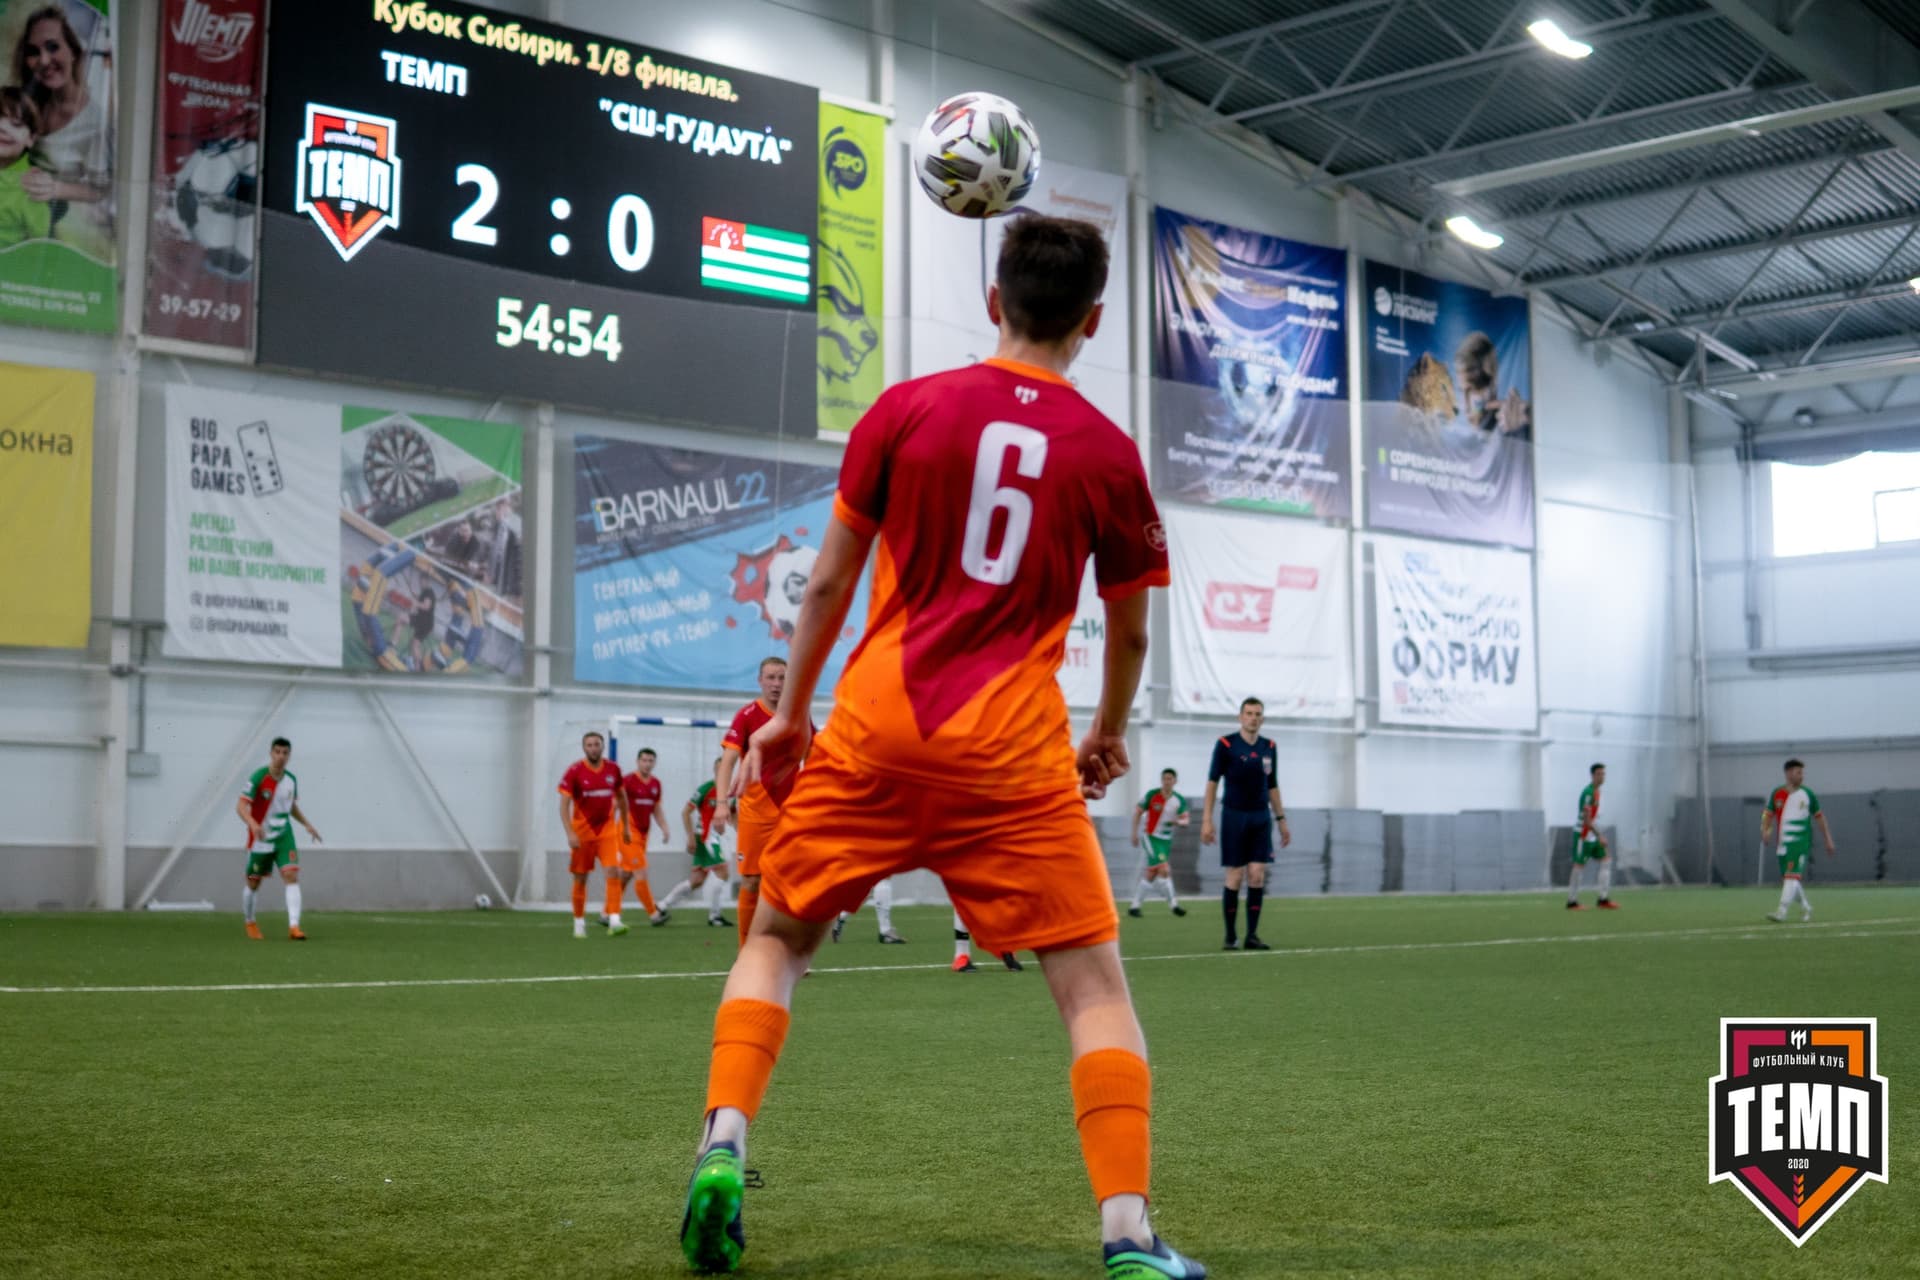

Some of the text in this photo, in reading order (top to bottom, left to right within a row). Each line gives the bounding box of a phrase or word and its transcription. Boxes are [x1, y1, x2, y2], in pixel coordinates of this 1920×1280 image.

[373, 0, 740, 103] Кубок Сибири. 1/8 финала.
[380, 50, 468, 97] ТЕМП
[599, 98, 793, 165] "СШ-ГУДАУТА"
[308, 149, 391, 212] ТЕМП
[451, 163, 499, 247] 2
[607, 193, 656, 273] 0
[160, 293, 242, 323] 39-57-29
[495, 297, 623, 363] 54:54
[191, 417, 217, 442] BIG
[191, 443, 232, 469] PAPA
[191, 467, 246, 496] GAMES
[960, 420, 1049, 586] 6
[1392, 636, 1520, 686] ФОРМУ
